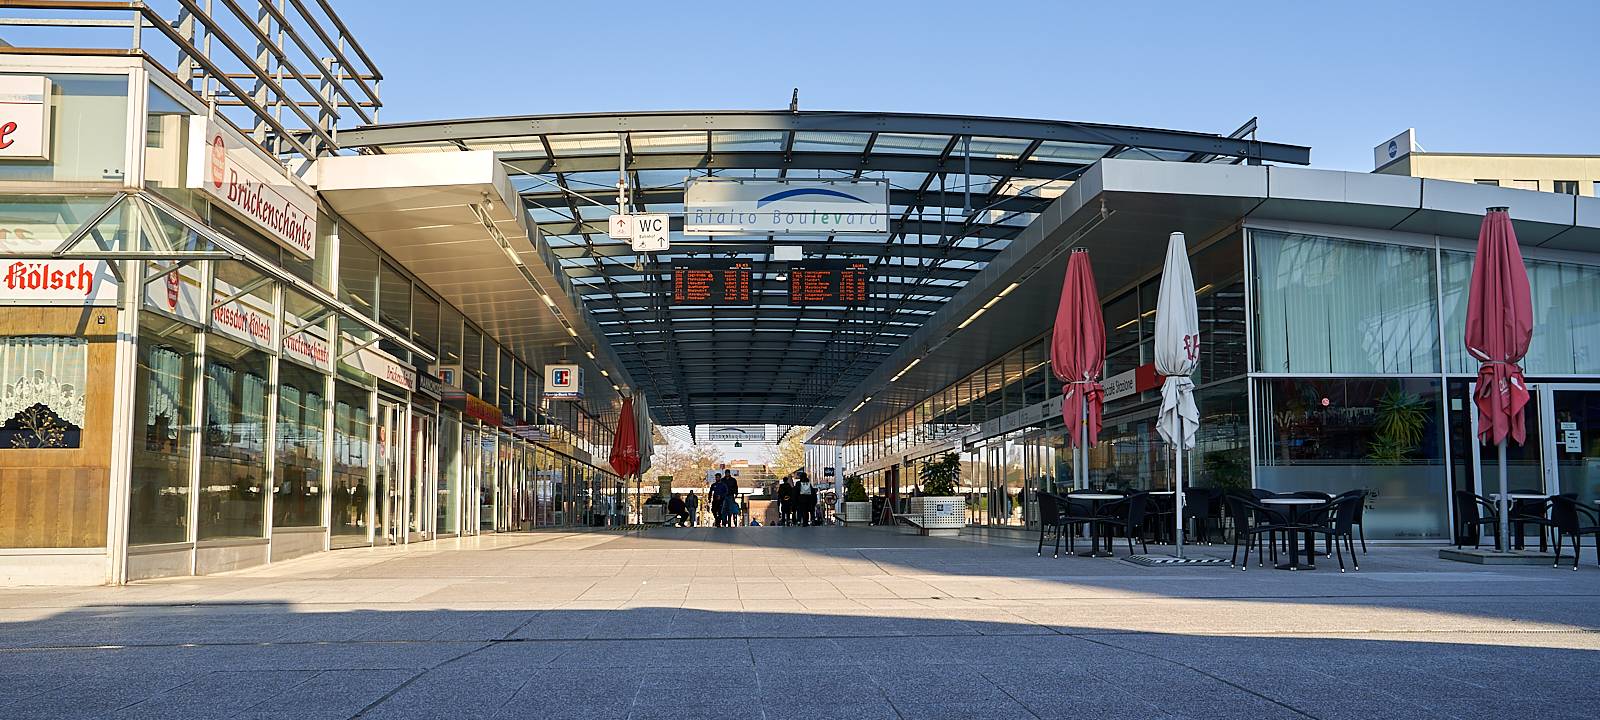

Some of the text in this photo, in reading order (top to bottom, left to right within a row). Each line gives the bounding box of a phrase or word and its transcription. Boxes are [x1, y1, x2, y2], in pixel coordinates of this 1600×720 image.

[227, 167, 312, 251] Brückenschänke
[695, 208, 879, 225] Rialto Boulevard
[639, 219, 662, 232] WC
[4, 261, 93, 295] Kölsch
